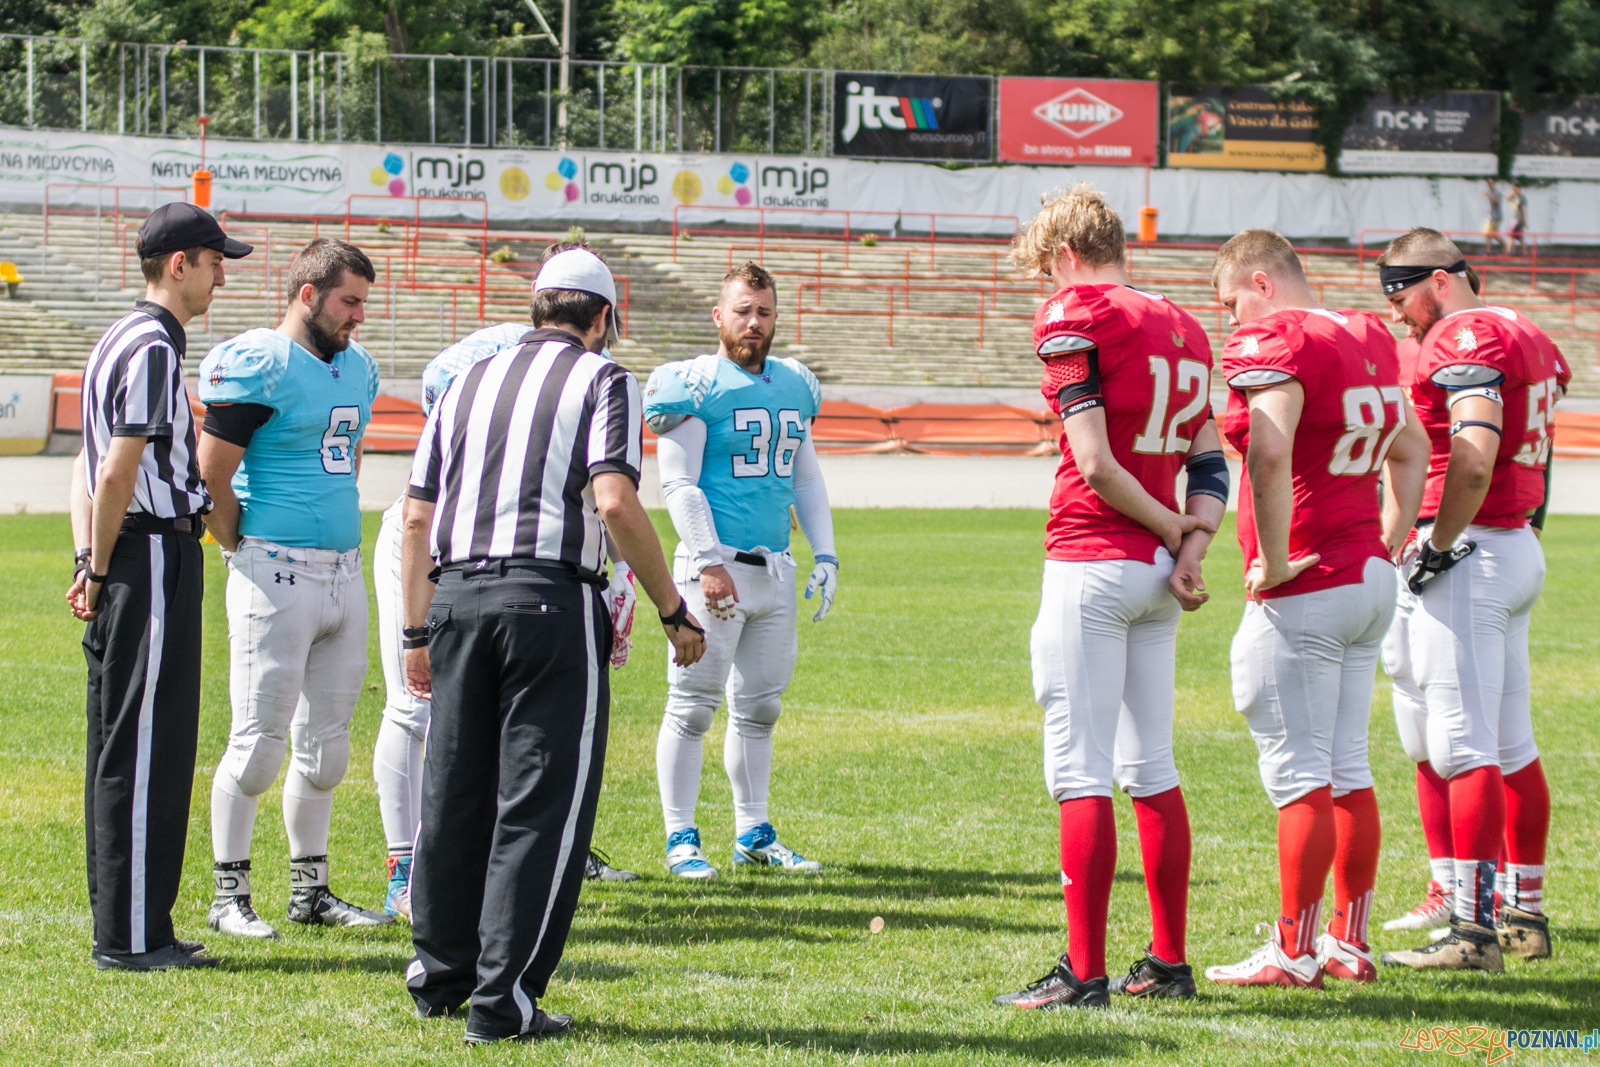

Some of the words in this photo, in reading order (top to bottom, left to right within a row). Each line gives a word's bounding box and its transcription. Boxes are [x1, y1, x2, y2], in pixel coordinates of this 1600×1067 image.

[841, 81, 907, 144] jtc
[1046, 103, 1112, 122] KUHN
[1229, 114, 1268, 127] Vasco
[1270, 114, 1287, 127] da
[1375, 110, 1429, 130] nc+
[1547, 115, 1600, 136] nc+
[976, 132, 986, 143] IT
[1024, 144, 1039, 155] be
[1079, 146, 1094, 156] be
[1095, 145, 1132, 157] KUHN
[27, 154, 115, 173] MEDYCYNA
[255, 165, 342, 182] MEDYCYNA
[416, 154, 485, 187] mjp
[590, 158, 658, 192] mjp
[762, 162, 829, 196] mjp
[590, 191, 659, 205] drukarnia
[763, 195, 829, 208] drukarnia
[1132, 355, 1211, 455] 12
[318, 405, 361, 475] 6
[1328, 384, 1407, 476] 87
[731, 407, 805, 478] 36
